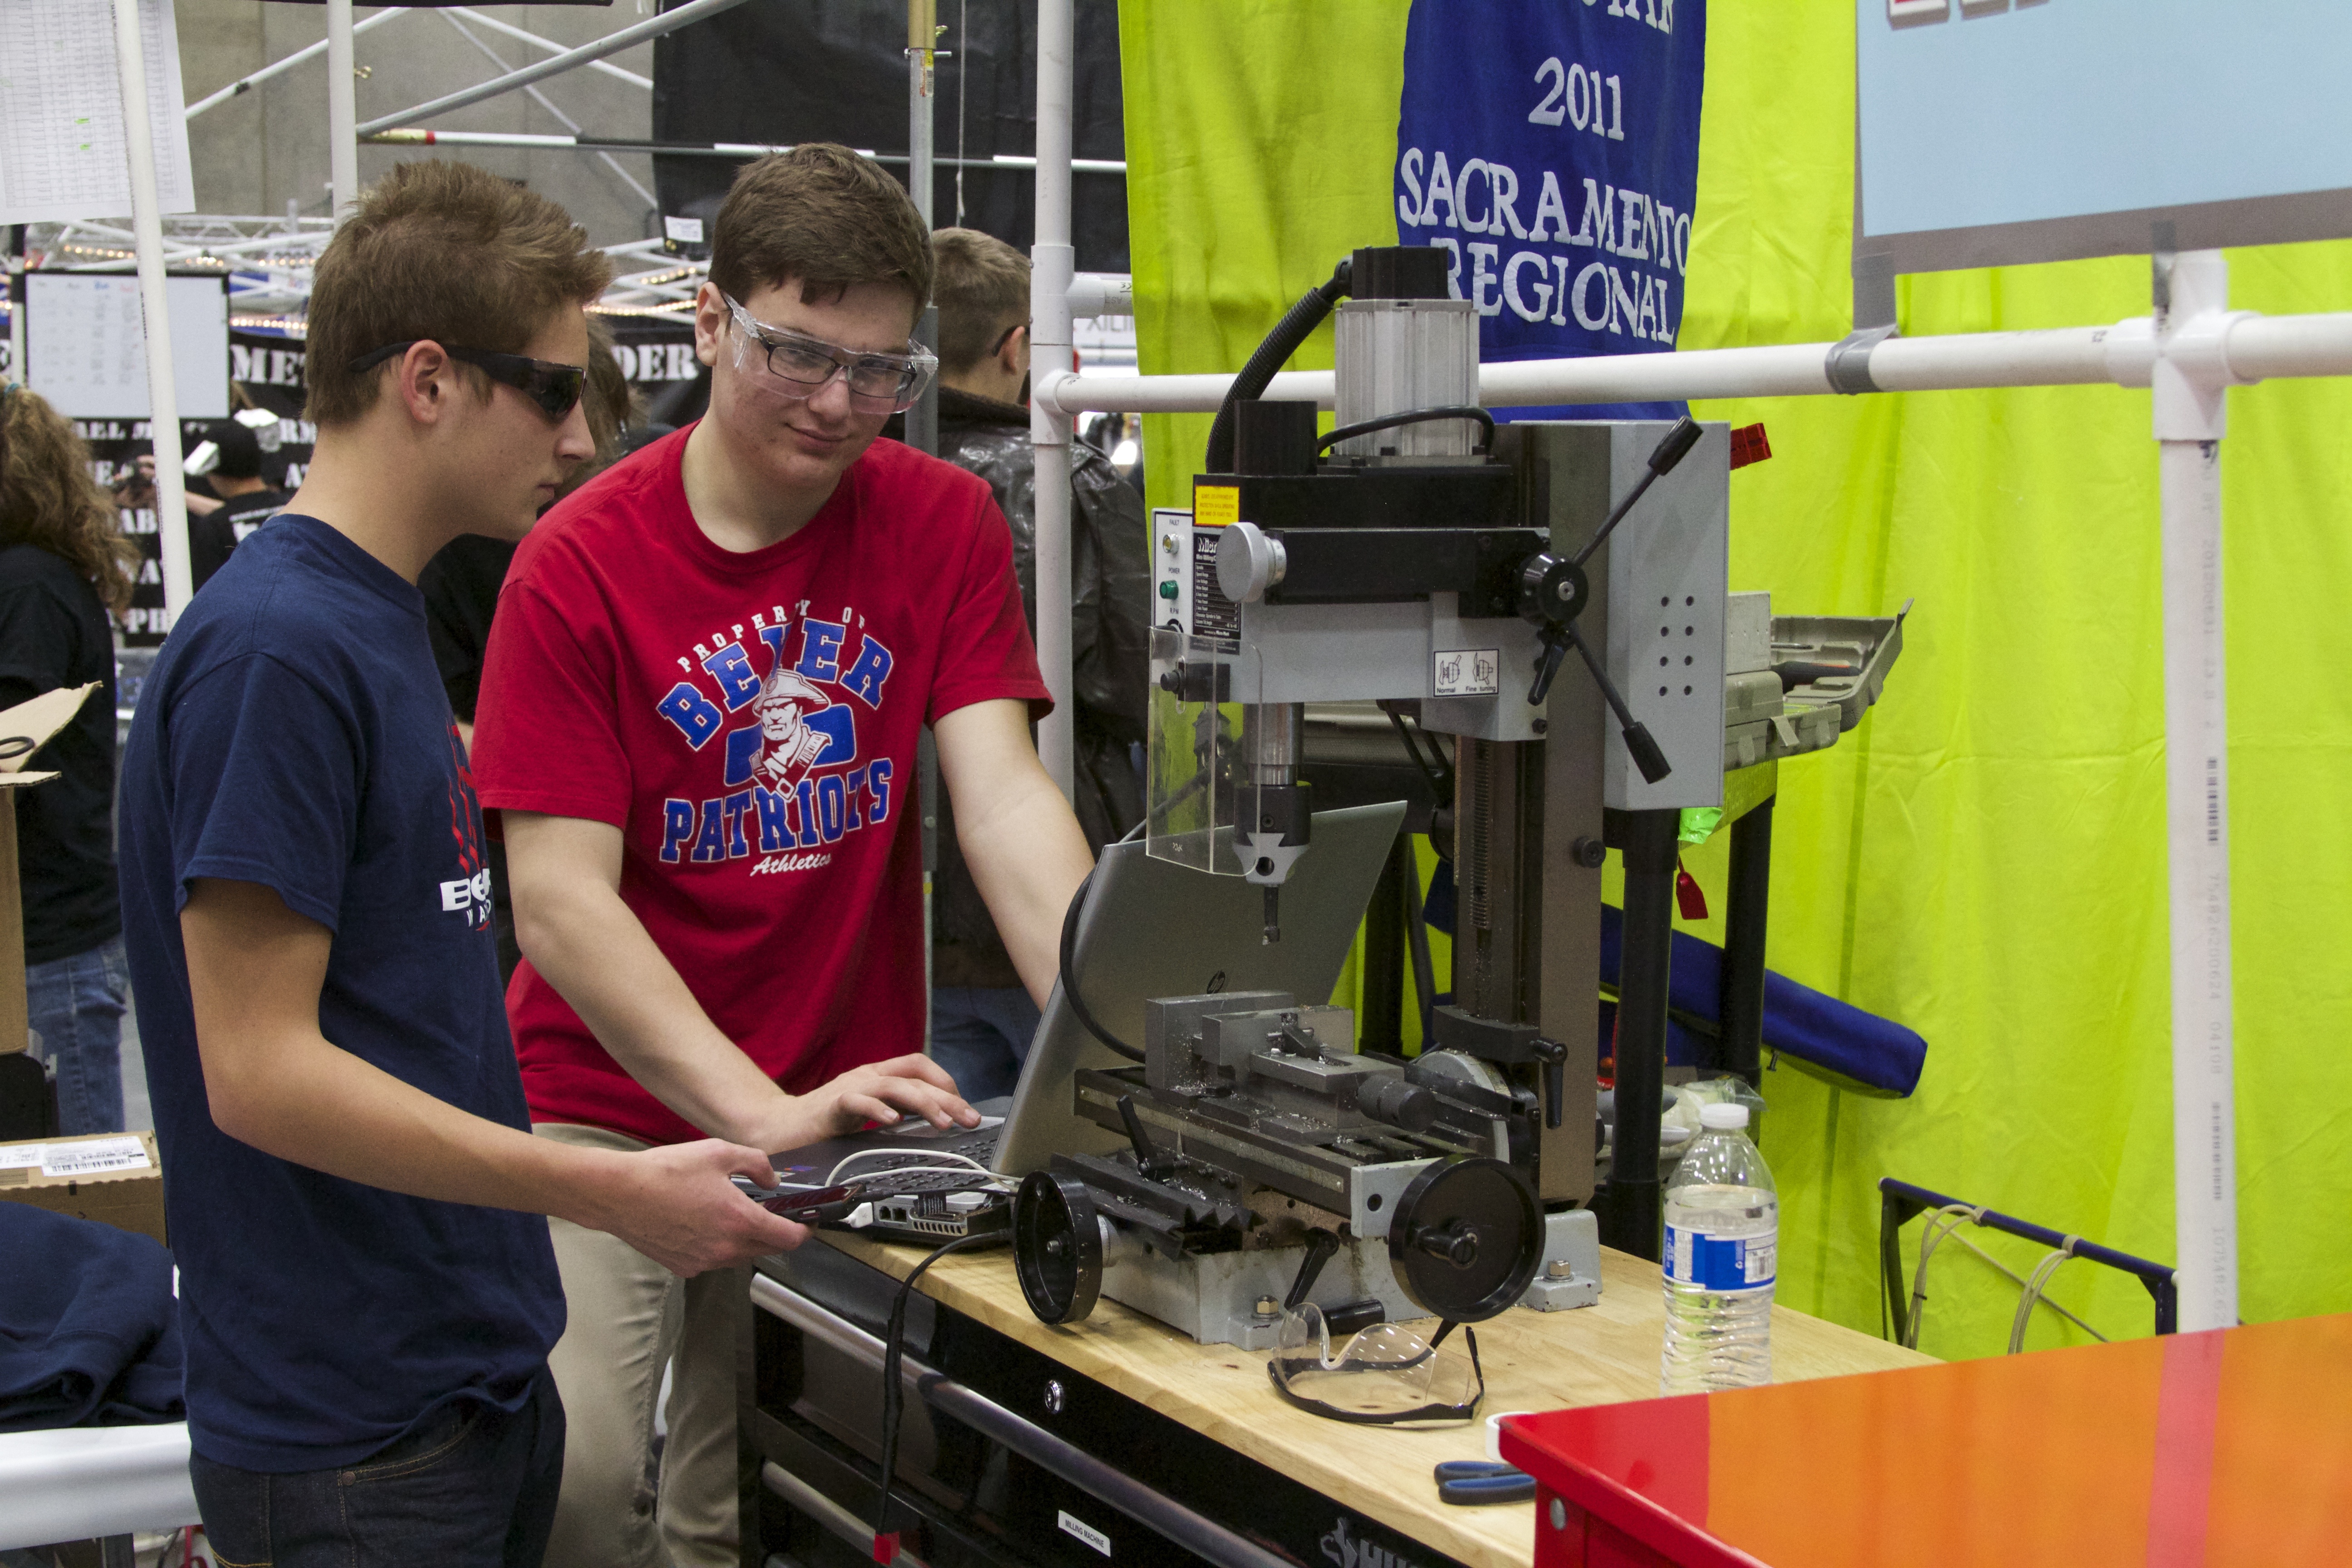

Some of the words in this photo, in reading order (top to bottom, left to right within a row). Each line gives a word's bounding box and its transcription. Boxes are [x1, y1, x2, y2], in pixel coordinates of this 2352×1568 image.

[1528, 57, 1625, 141] 2011
[1399, 147, 1691, 277] SACRAMENTO
[1431, 237, 1675, 345] REGIONAL
[659, 757, 893, 863] PATRIOTS
[750, 853, 832, 877] Athletics
[1065, 1519, 1083, 1535] MILLING
[1083, 1529, 1104, 1548] MACHINE
